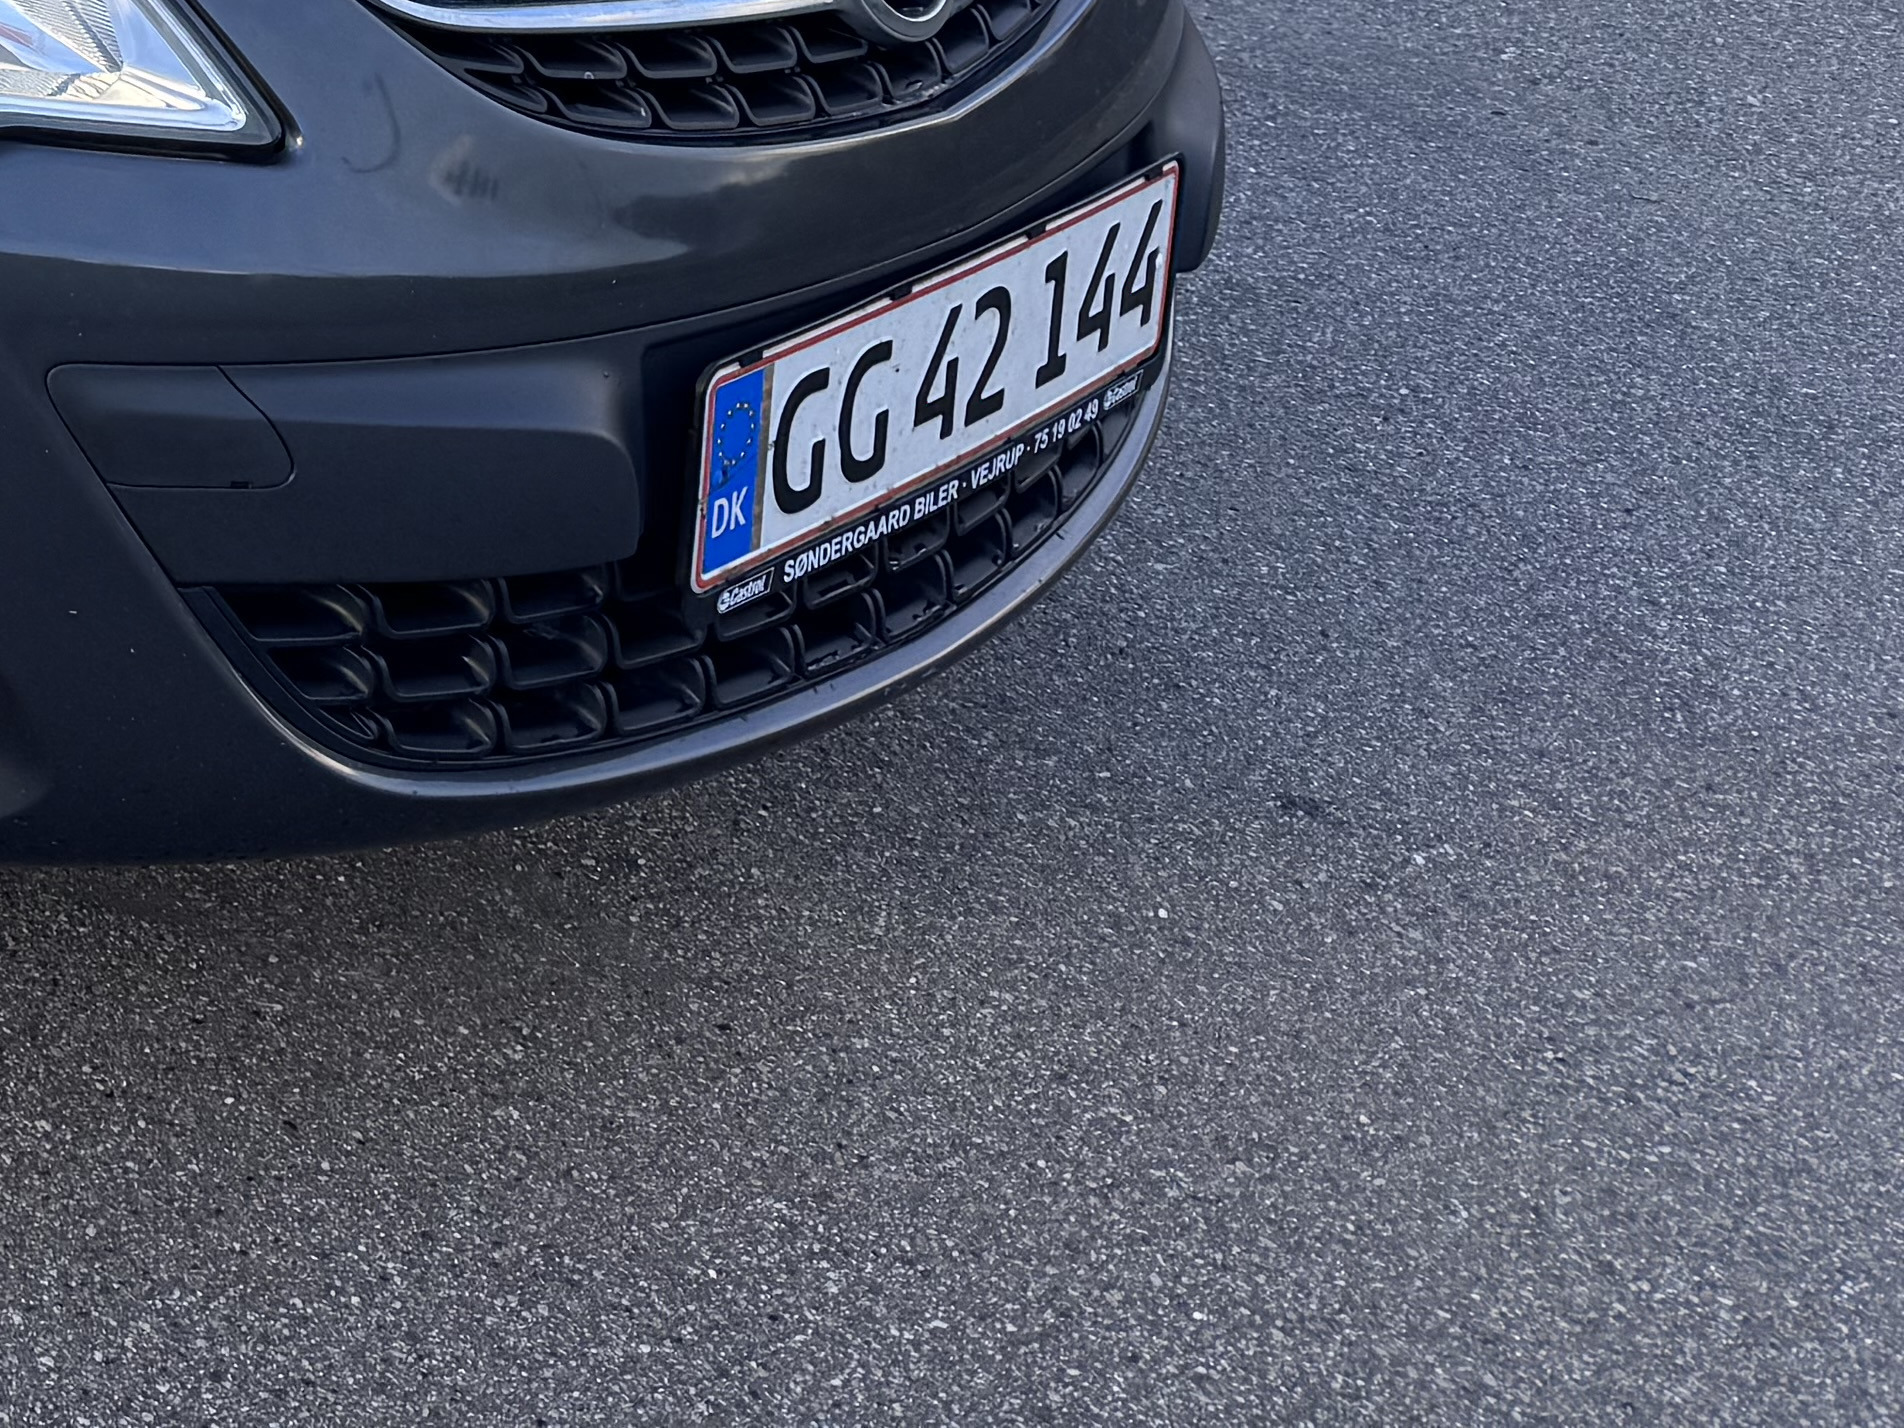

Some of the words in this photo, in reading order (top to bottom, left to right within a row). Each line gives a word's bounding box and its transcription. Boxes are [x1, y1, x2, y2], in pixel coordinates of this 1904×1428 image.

[771, 339, 893, 515] GG
[913, 285, 1012, 440] 42
[1035, 199, 1163, 390] 144
[711, 485, 746, 539] DK
[783, 503, 910, 583] SØNDERGAARD
[913, 479, 959, 521] BILER
[970, 443, 1025, 489] VEJRUP
[1033, 432, 1049, 454] 75
[1051, 424, 1066, 443] 19
[1067, 410, 1082, 433] 02
[1083, 398, 1099, 424] 49
[728, 574, 767, 607] Castrol
